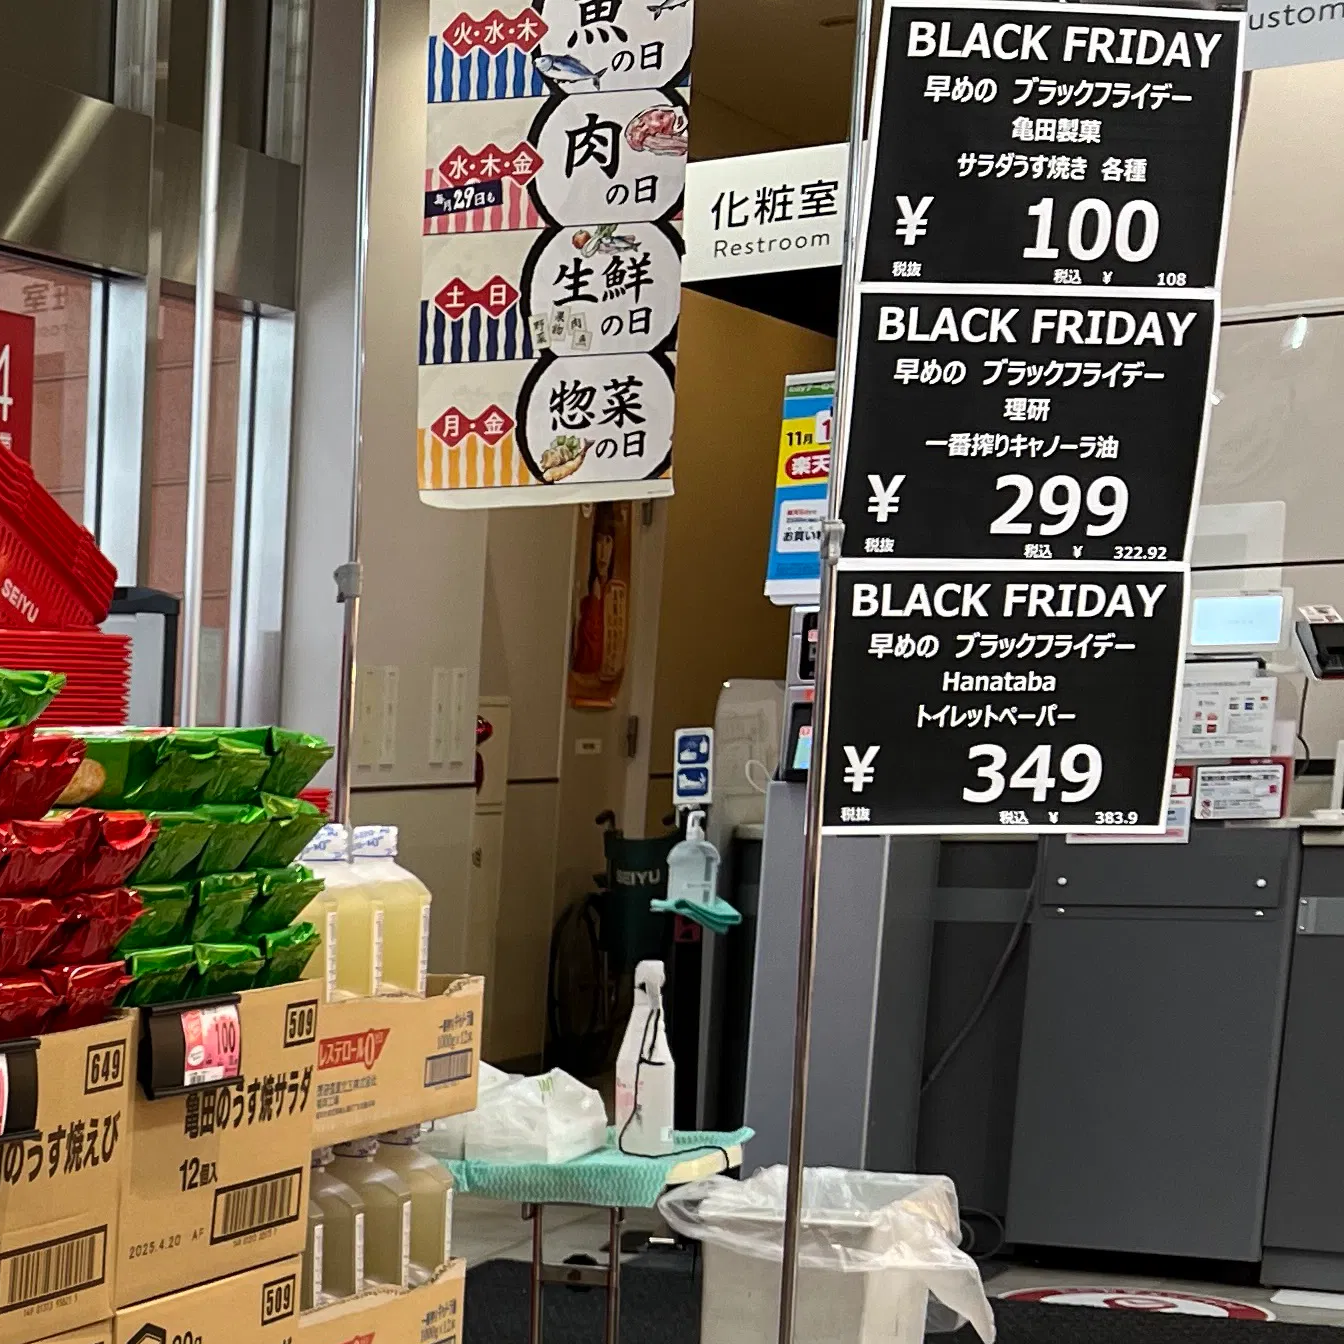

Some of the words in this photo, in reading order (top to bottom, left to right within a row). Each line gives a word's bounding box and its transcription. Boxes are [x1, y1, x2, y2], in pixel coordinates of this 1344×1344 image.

[453, 15, 538, 44] 火・水・木
[907, 21, 1052, 61] BLACK
[1063, 27, 1223, 68] FRIDAY
[611, 41, 664, 72] の日
[924, 75, 998, 104] 早めの
[1012, 77, 1193, 110] ブラックフライデー
[1012, 117, 1102, 144] 亀田製菓
[565, 113, 622, 180] 肉
[449, 151, 531, 180] 水・木・金
[957, 153, 1088, 182] サラダうす焼き
[1101, 157, 1148, 183] 各種
[606, 176, 659, 206] の日
[712, 180, 838, 230] 化粧室
[895, 196, 935, 246] ¥
[1022, 197, 1160, 263] 100
[714, 232, 830, 258] Restroom
[552, 256, 655, 307] 生鮮
[892, 261, 921, 278] 税抜
[1053, 269, 1082, 285] 税込
[1157, 272, 1186, 287] 108
[600, 307, 653, 337] の日
[877, 306, 1019, 344] BLACK
[1031, 309, 1196, 347] FRIDAY
[893, 359, 966, 385] 早めの
[982, 359, 1165, 389] ブラックフライデー
[549, 375, 647, 431] 惣菜
[1003, 397, 1051, 422] 理研
[441, 412, 506, 438] 月・金
[595, 430, 646, 459] の日
[925, 433, 1118, 460] 一番搾りキャノーラ油
[867, 474, 906, 523] ¥
[989, 474, 1129, 537] 299
[864, 537, 895, 553] 税抜
[1024, 543, 1052, 559] 税込
[1114, 546, 1167, 560] 322.92
[0, 577, 40, 624] SEIYU
[852, 583, 992, 618] BLACK
[1003, 584, 1167, 618] FRIDAY
[868, 633, 940, 659] 早めの
[955, 633, 1136, 659] ブラックフライデー
[942, 671, 1057, 692] Hanataba
[916, 704, 1076, 728] トイレットペーパー
[843, 745, 881, 793] ¥
[962, 743, 1103, 804] 349
[840, 807, 871, 823] 税抜
[999, 810, 1029, 825] 税込
[1095, 812, 1138, 826] 383.9
[616, 868, 661, 886] SEIYU
[289, 1006, 314, 1039] 509
[215, 1020, 236, 1056] 100
[90, 1052, 122, 1085] 649
[184, 1064, 314, 1140] 亀田のうす焼サラダ
[179, 1156, 218, 1192] 12個入
[265, 1286, 291, 1317] 509
